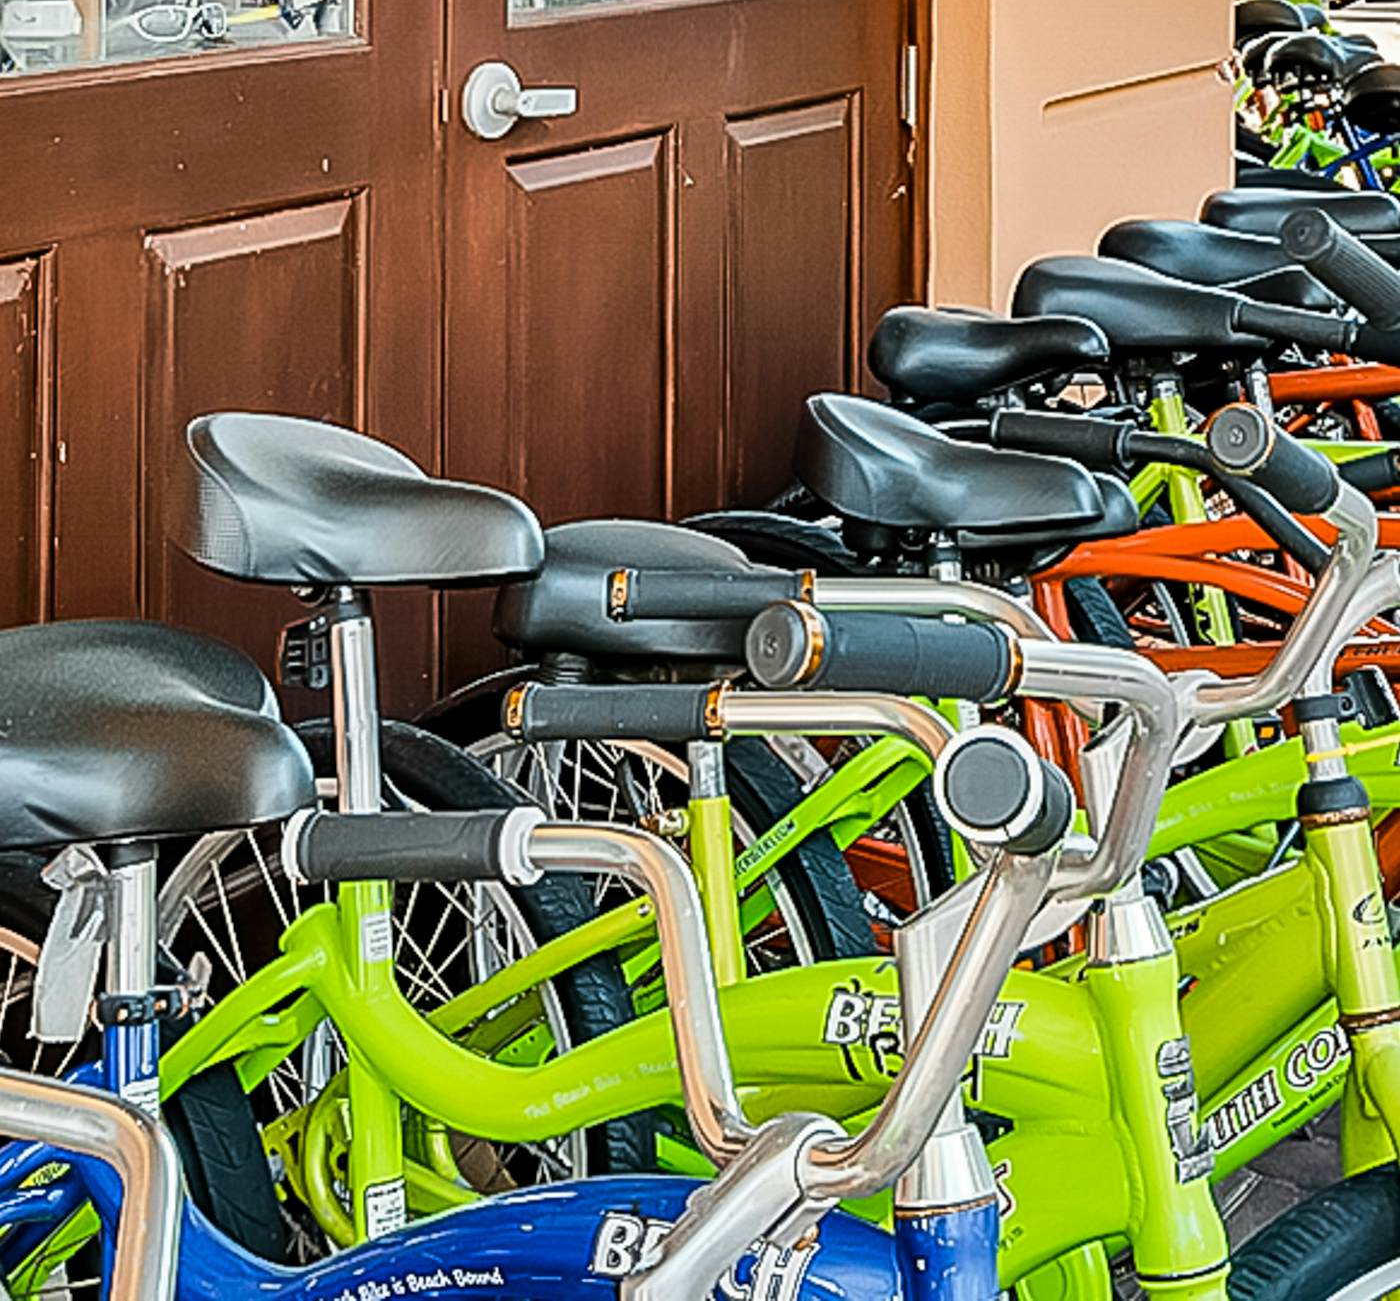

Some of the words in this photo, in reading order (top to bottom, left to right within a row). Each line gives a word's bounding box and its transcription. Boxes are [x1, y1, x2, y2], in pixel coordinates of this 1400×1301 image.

[824, 986, 1027, 1058] BEH
[391, 1276, 405, 1295] is
[406, 1268, 452, 1293] Beach
[452, 1266, 505, 1288] Bound
